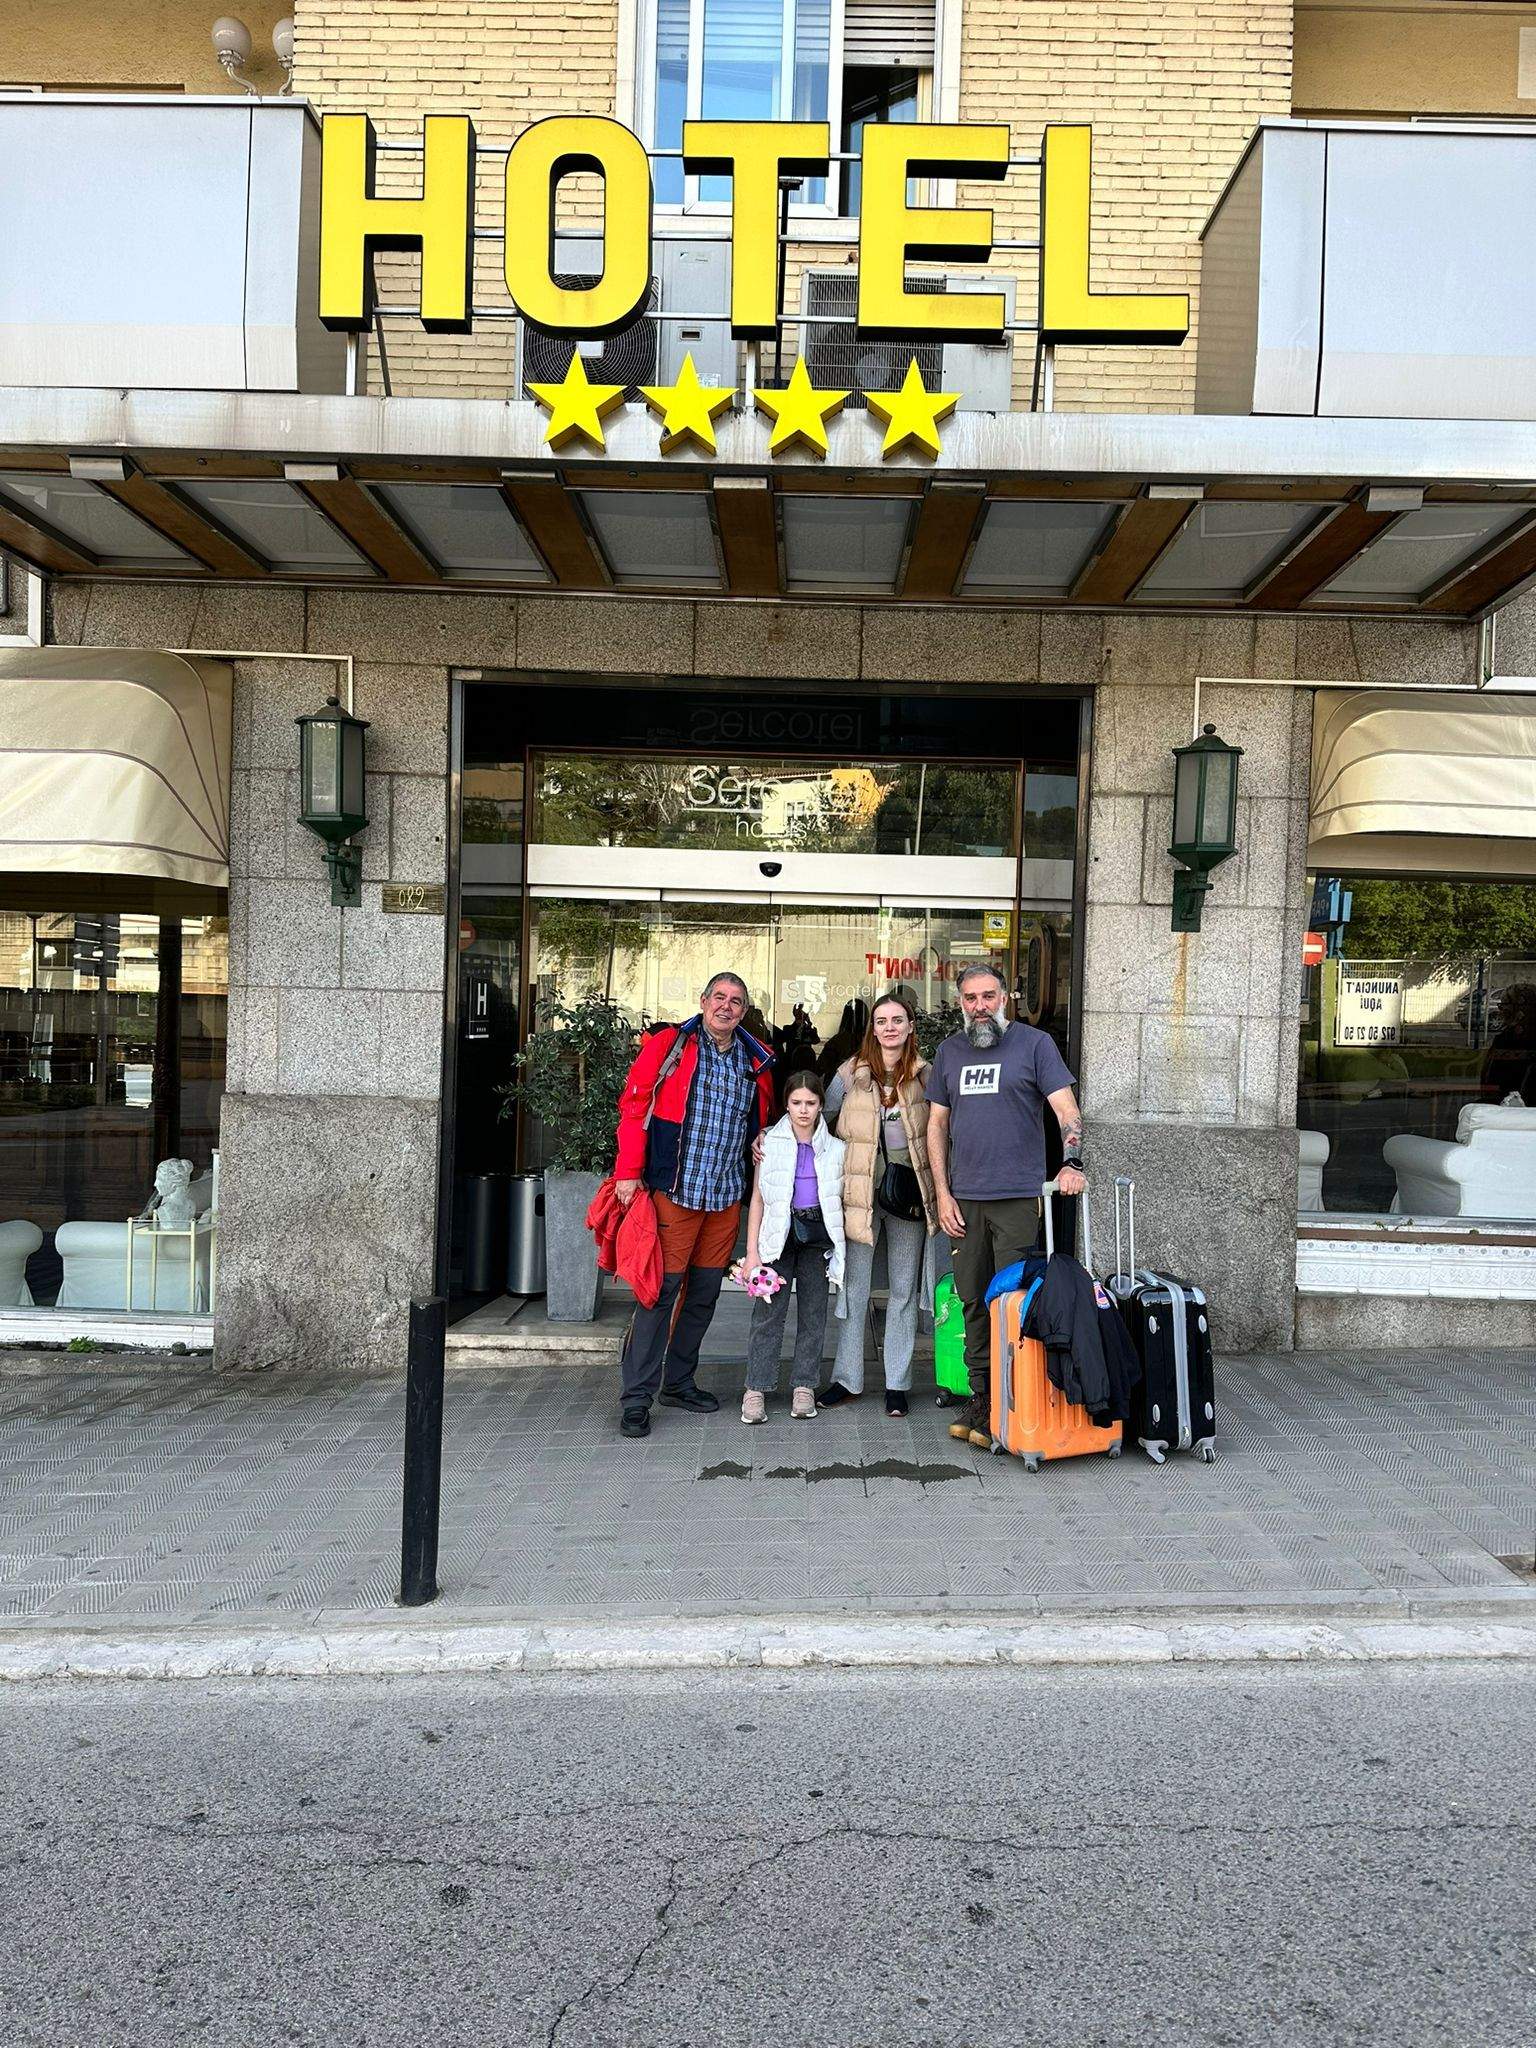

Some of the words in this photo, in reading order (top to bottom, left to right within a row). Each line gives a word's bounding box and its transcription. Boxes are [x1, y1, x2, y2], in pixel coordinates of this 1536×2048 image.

[317, 112, 1190, 347] HOTEL
[477, 982, 487, 1015] H
[964, 1068, 995, 1085] HH
